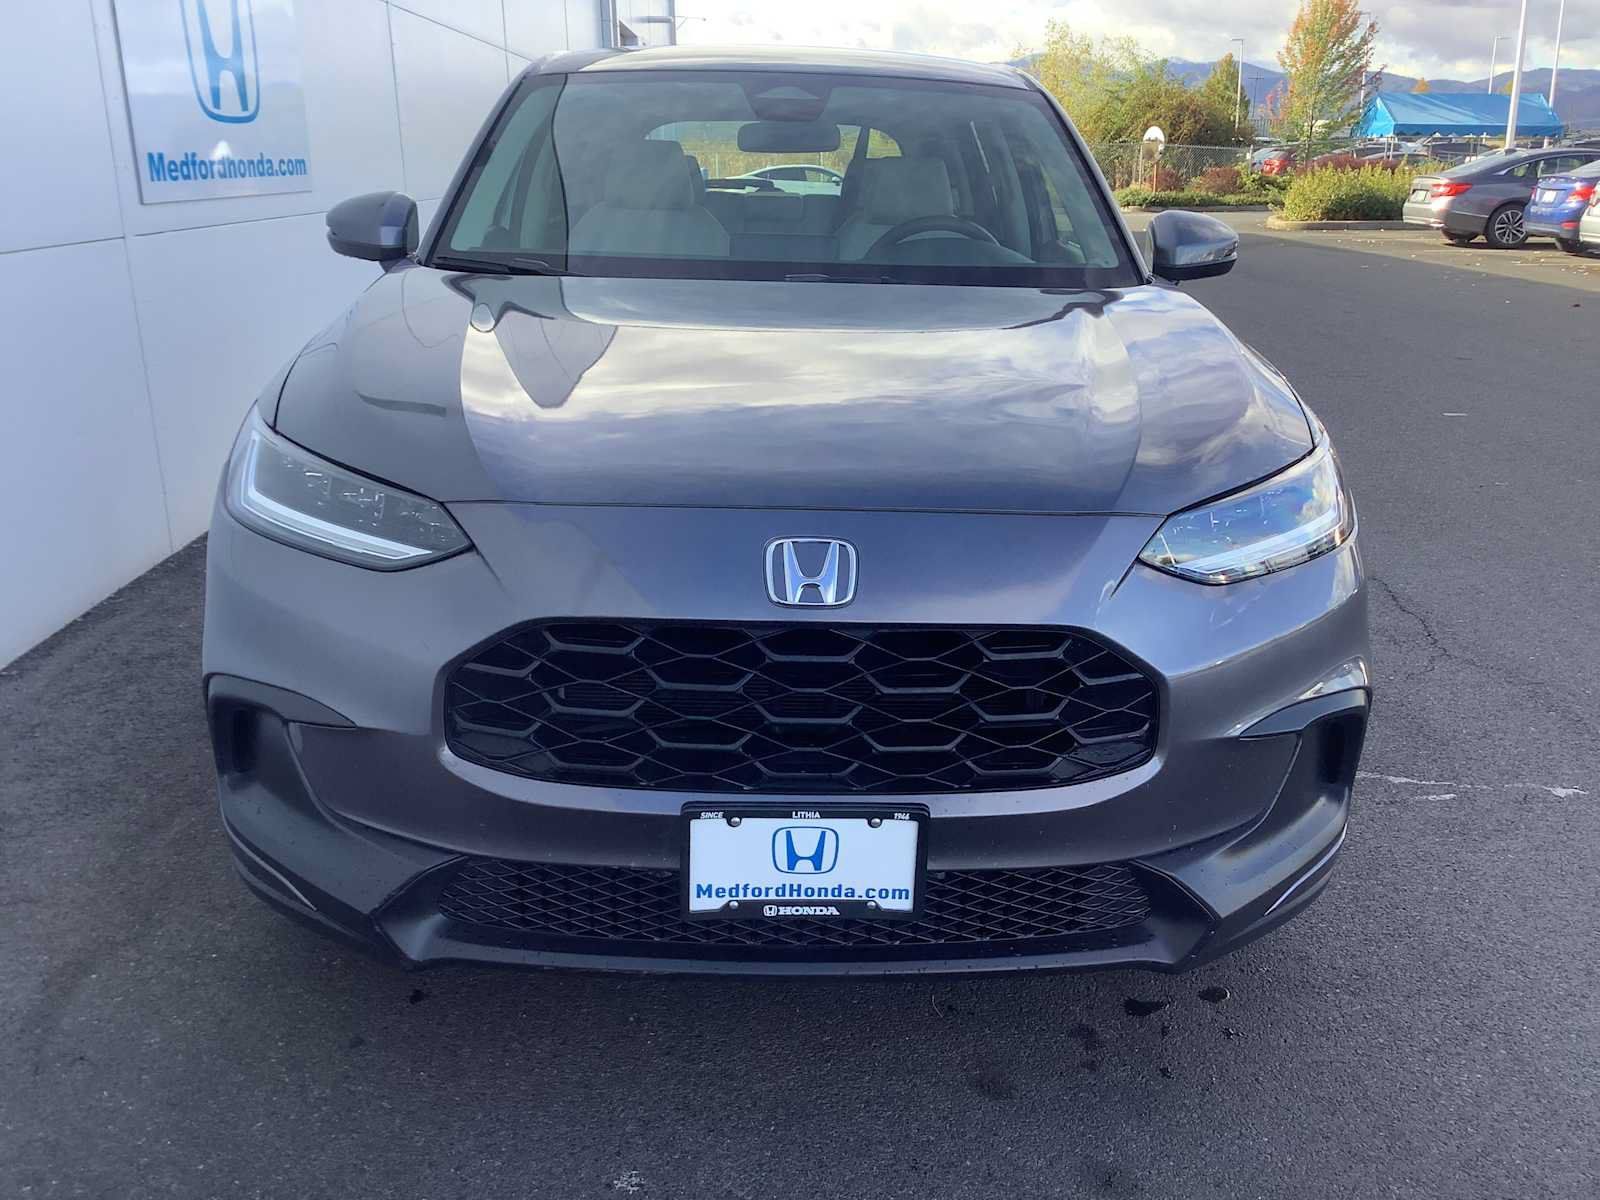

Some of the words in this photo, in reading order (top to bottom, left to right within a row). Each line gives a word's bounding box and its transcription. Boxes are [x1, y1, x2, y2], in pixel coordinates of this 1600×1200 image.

[147, 151, 307, 182] Medfordhonda.com
[700, 811, 724, 819] SINCE
[792, 811, 821, 819] LITHIA
[696, 883, 910, 900] MedfordHonda.com
[778, 906, 840, 916] HONDA
